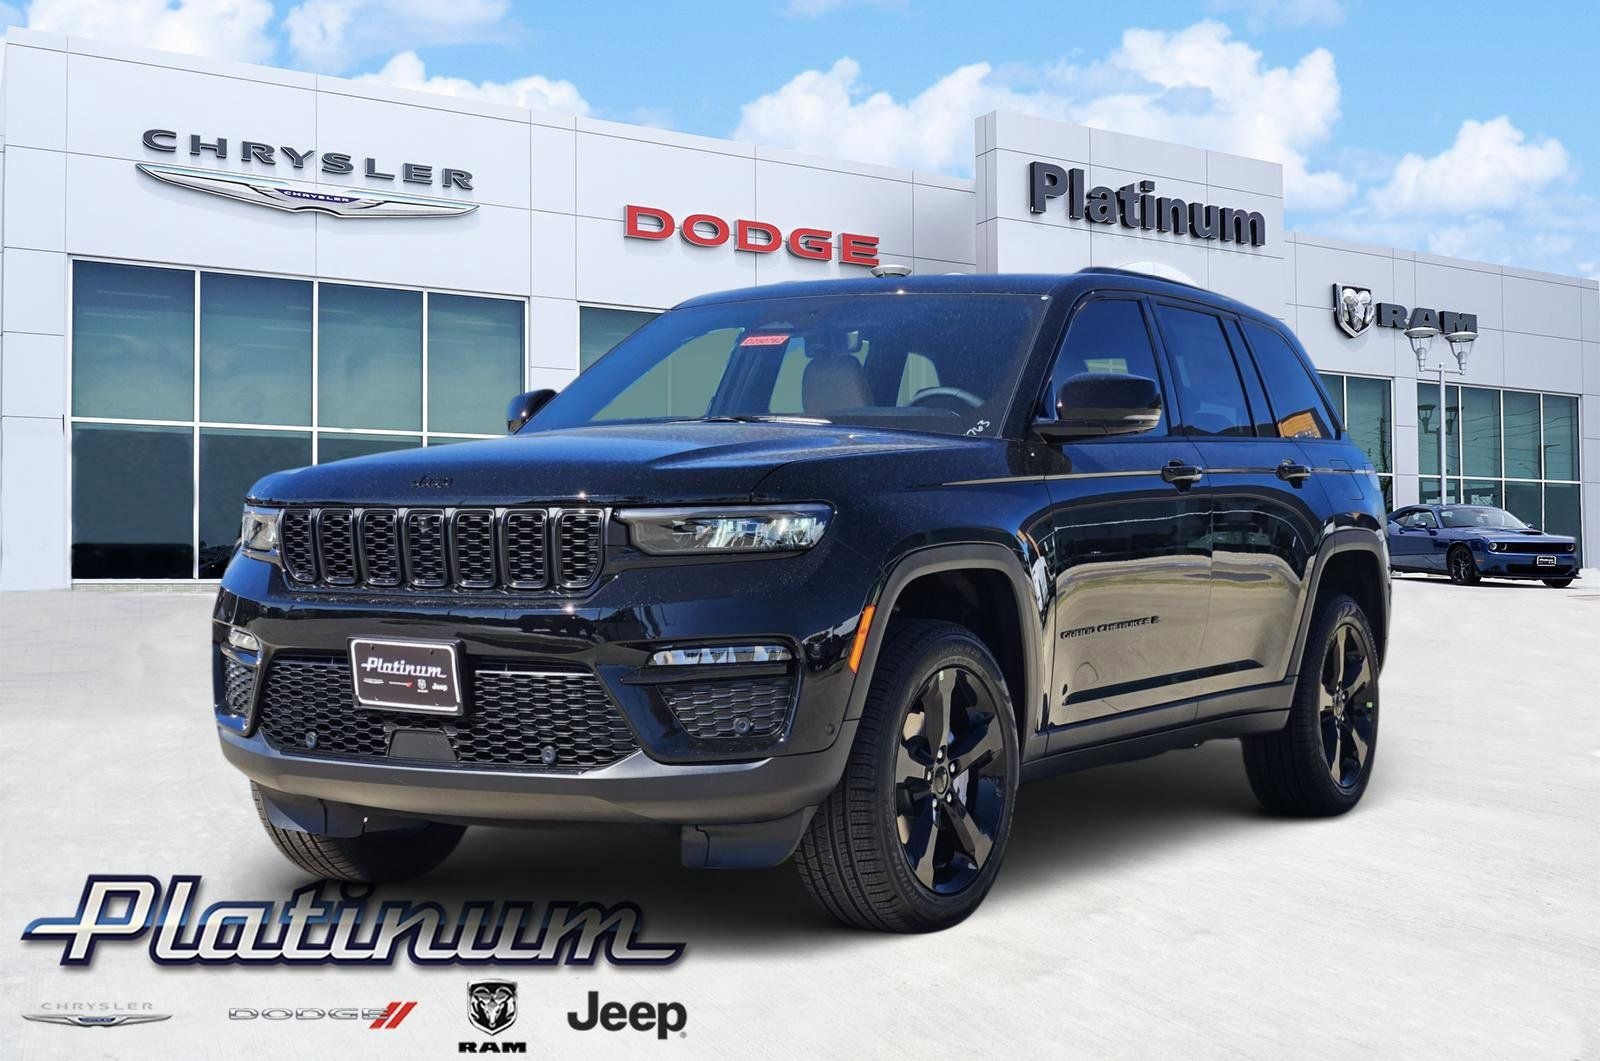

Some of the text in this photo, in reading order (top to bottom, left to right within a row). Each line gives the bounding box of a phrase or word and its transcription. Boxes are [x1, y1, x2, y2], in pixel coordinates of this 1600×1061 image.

[142, 128, 474, 190] CHRYSLER
[283, 190, 349, 202] CHRYSLER
[1029, 161, 1266, 247] Platinum
[624, 204, 880, 267] DODGE
[1376, 302, 1478, 335] RAM
[361, 657, 447, 678] Platinum
